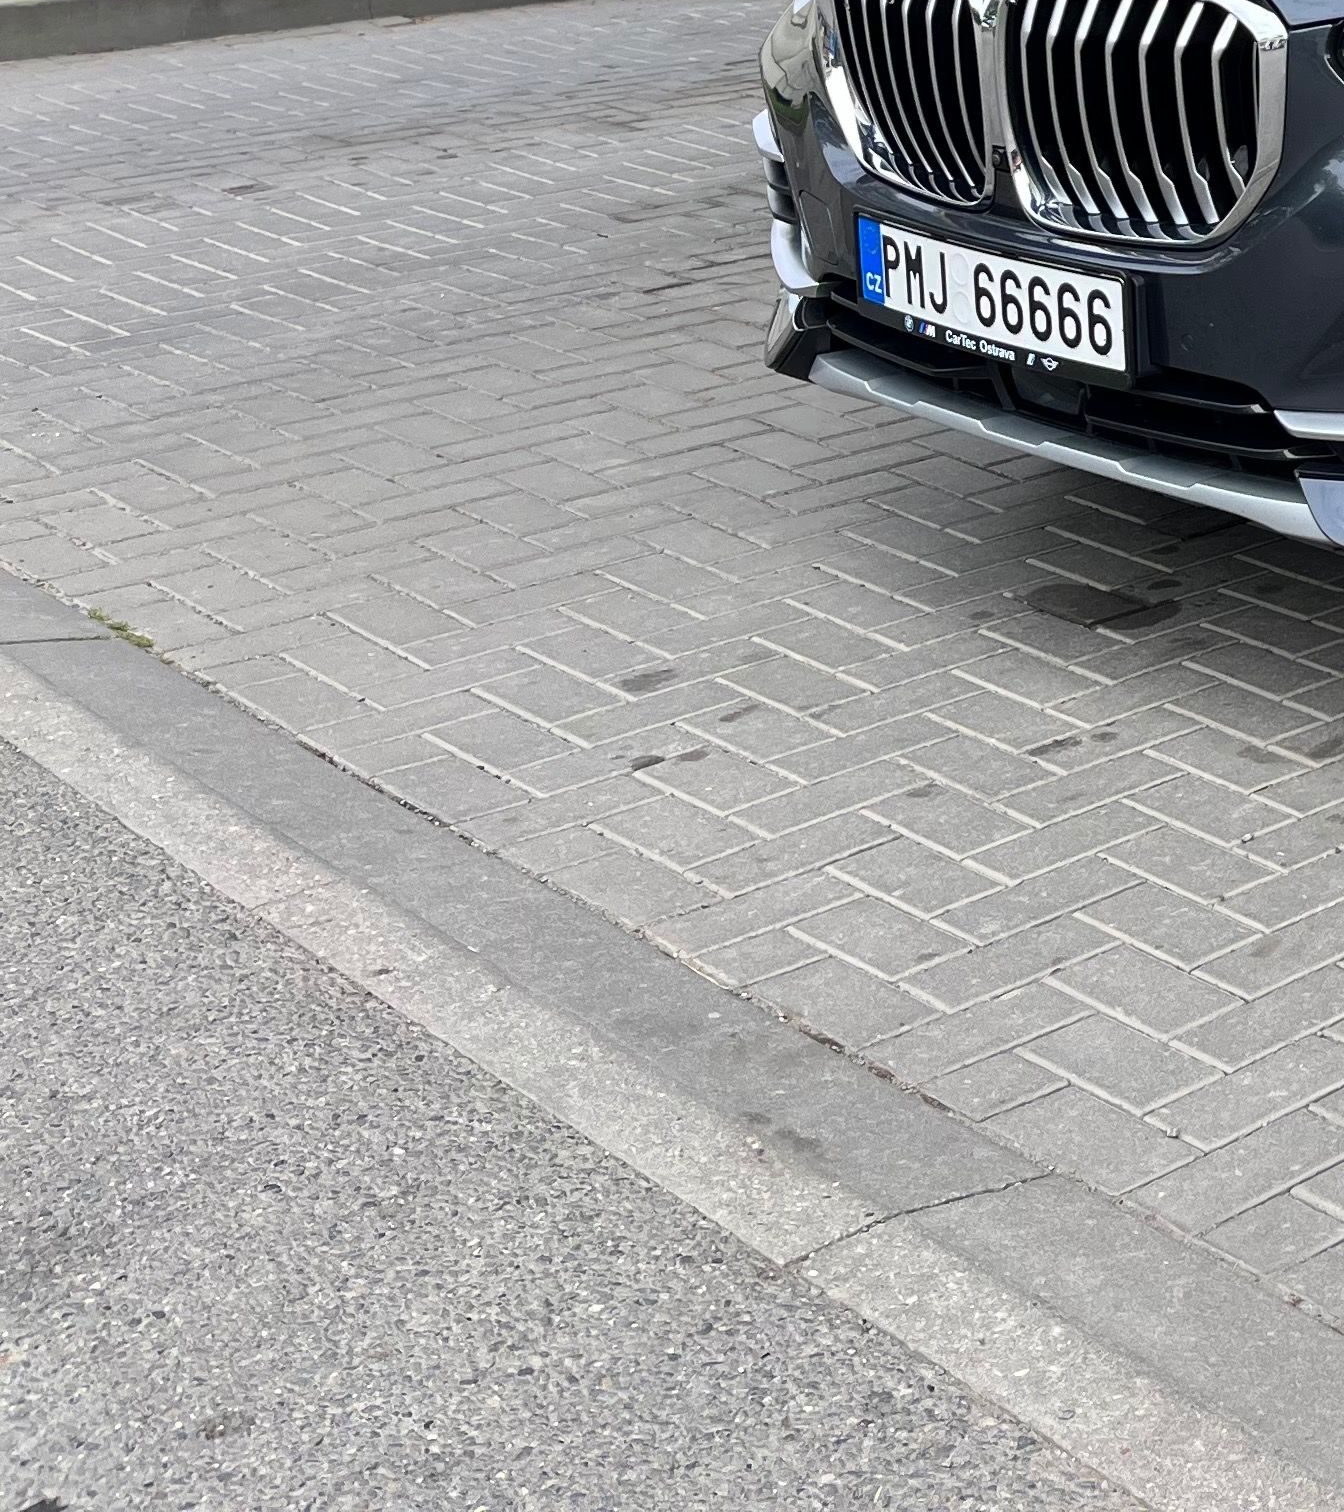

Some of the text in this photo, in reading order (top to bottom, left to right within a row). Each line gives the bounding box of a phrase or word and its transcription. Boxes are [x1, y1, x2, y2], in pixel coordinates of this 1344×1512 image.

[865, 271, 883, 294] CZ
[882, 234, 1113, 356] PMJ 66666
[945, 329, 977, 351] CarTec
[979, 340, 1015, 361] Ostrava
